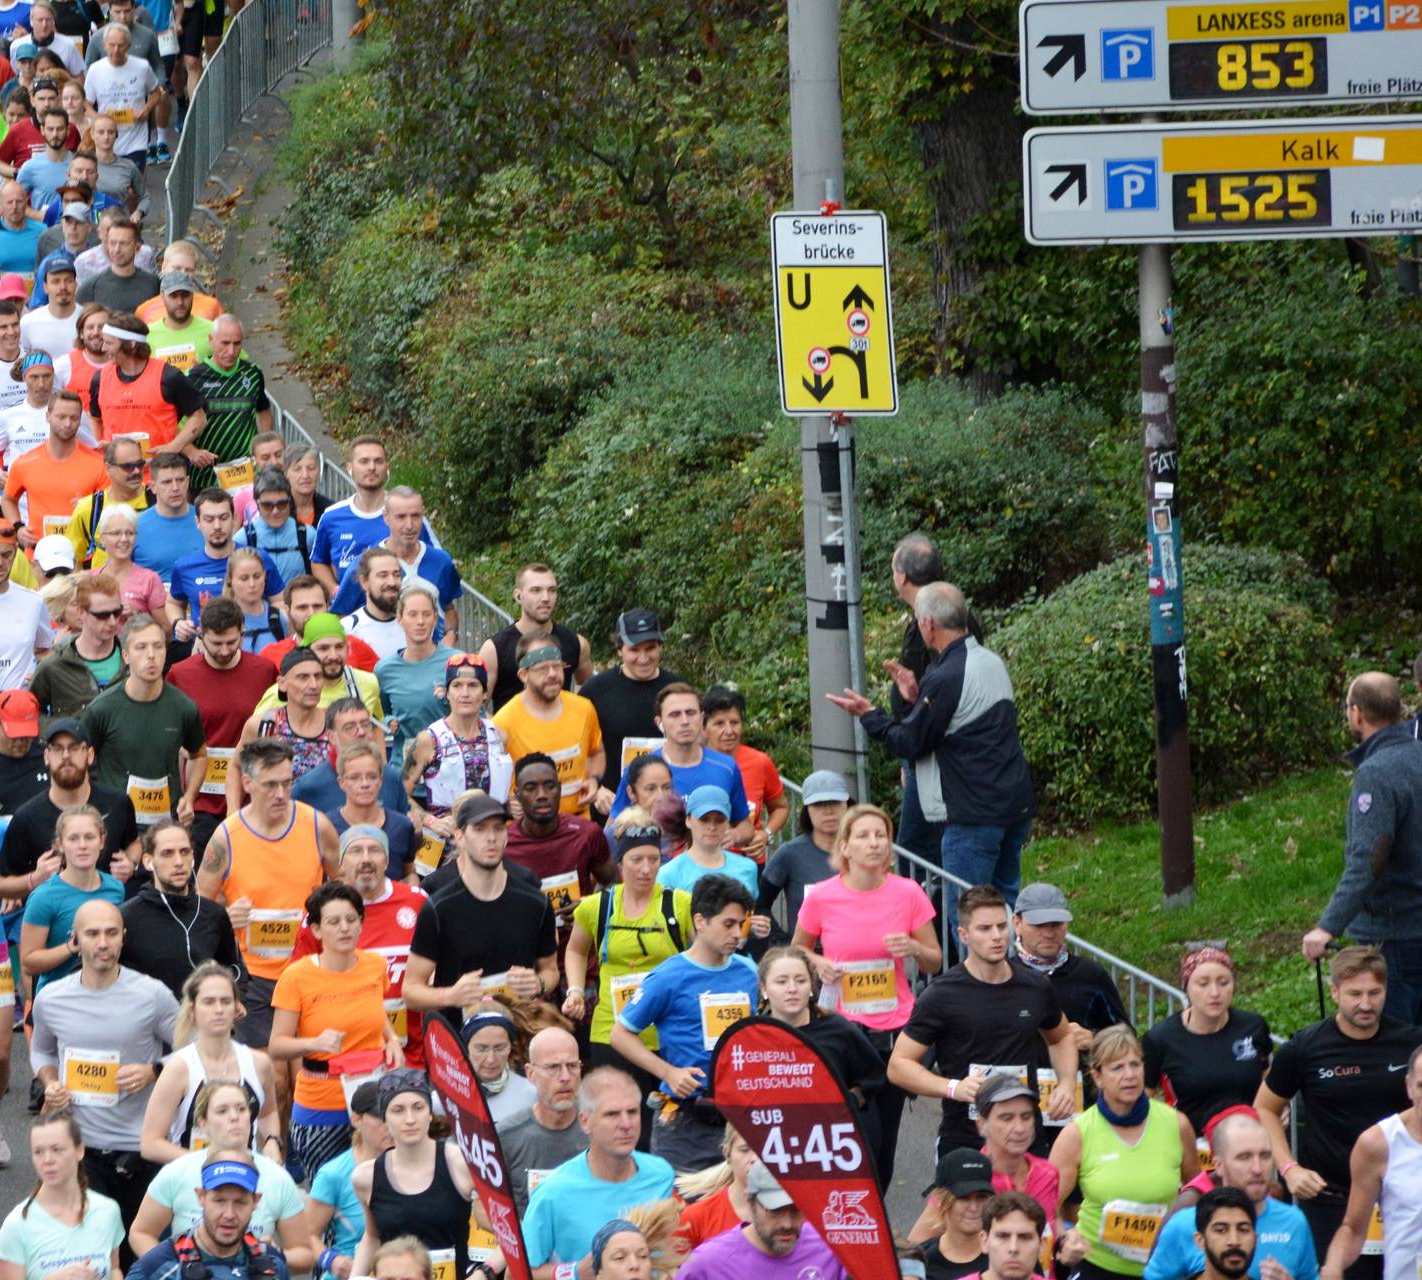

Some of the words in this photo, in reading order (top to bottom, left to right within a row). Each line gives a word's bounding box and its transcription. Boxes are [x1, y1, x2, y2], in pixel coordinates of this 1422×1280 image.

[1197, 10, 1286, 33] LANXESS
[1292, 13, 1346, 29] arena
[1354, 5, 1381, 25] P1
[1389, 4, 1421, 24] P2
[1217, 41, 1315, 92] 853
[1347, 78, 1381, 95] freie
[1282, 139, 1340, 162] Kalk
[1186, 174, 1318, 223] 1525
[792, 219, 864, 236] Severins-
[804, 244, 855, 260] brücke
[851, 339, 868, 350] 30t
[139, 790, 164, 801] 3476
[261, 922, 291, 934] 4528
[731, 1045, 796, 1072] #GENERALI
[77, 1063, 107, 1078] 4280
[769, 1064, 815, 1076] BEWEGT
[1319, 1065, 1361, 1079] SoCura
[736, 1077, 814, 1092] DEUTSCHLAND
[751, 1109, 784, 1125] SUB
[761, 1123, 863, 1175] 4:45
[1114, 1216, 1156, 1232] F1459
[826, 1230, 881, 1247] GENERALI
